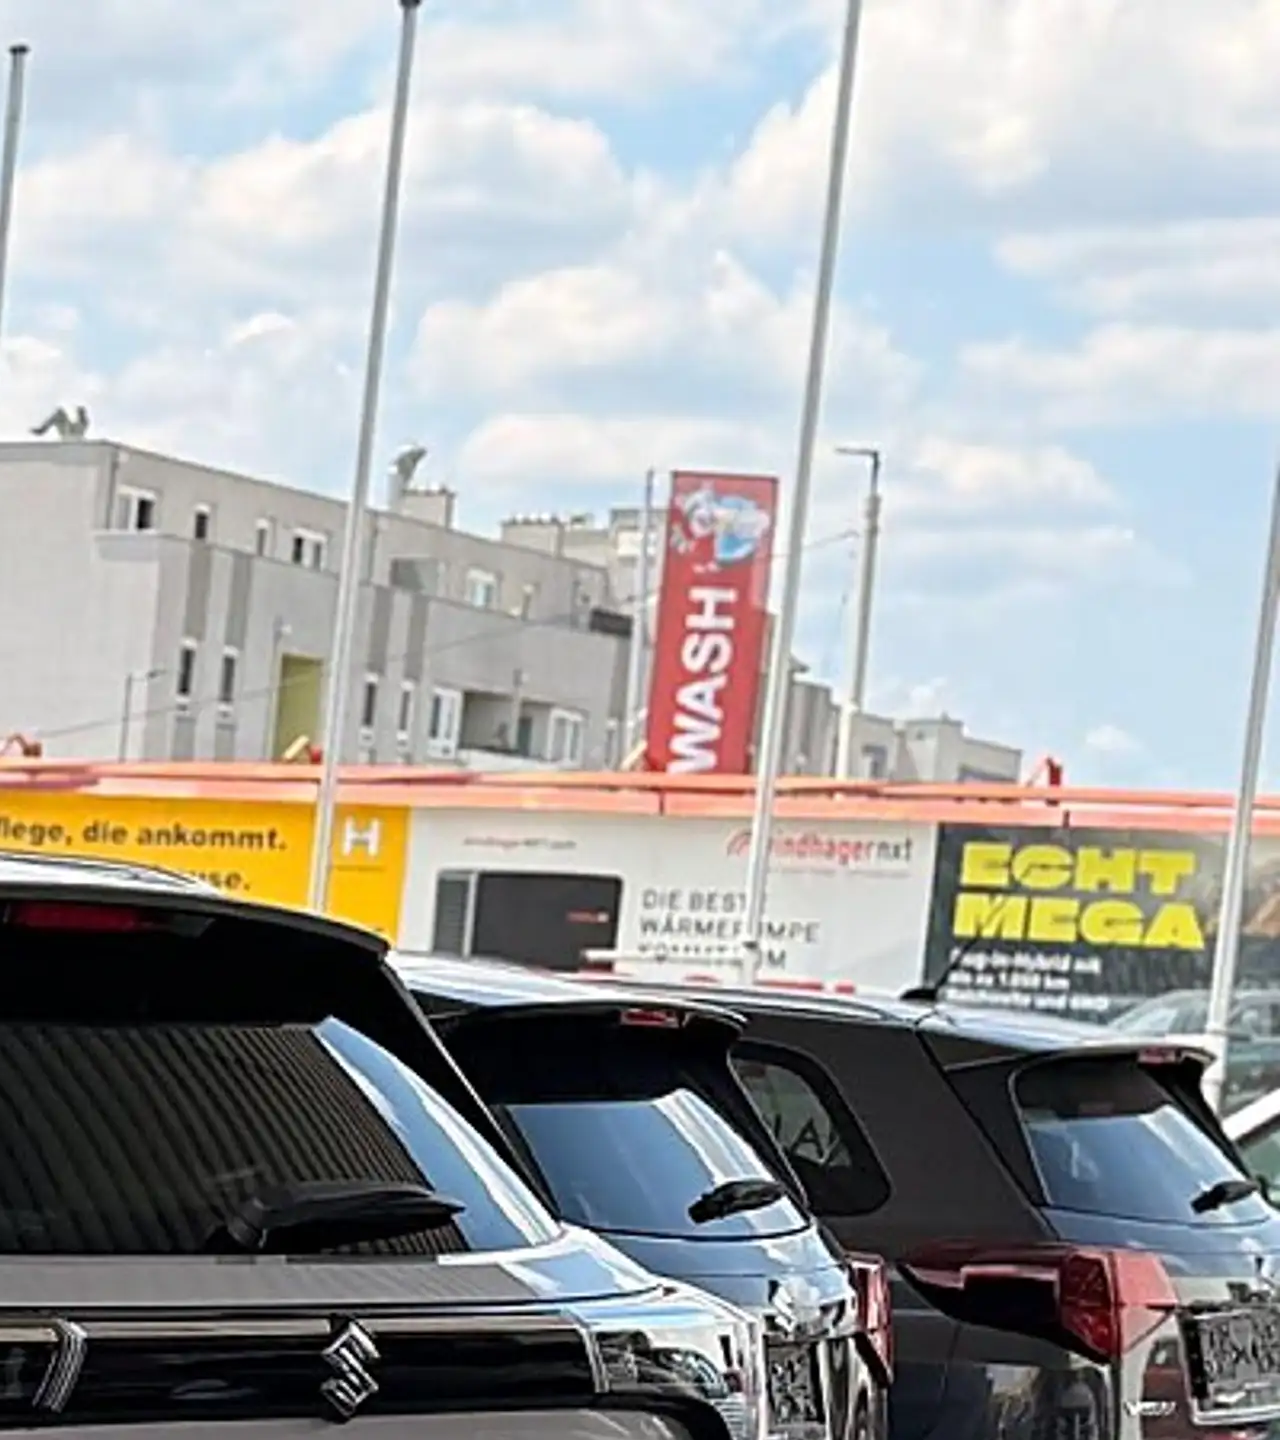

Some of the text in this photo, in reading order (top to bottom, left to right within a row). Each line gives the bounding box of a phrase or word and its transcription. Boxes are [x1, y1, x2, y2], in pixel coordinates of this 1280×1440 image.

[666, 587, 737, 775] WASH
[82, 820, 129, 845] die
[136, 823, 288, 851] ankommt.
[959, 841, 1195, 894] ECHT
[642, 888, 748, 914] DIE BEST
[952, 892, 1206, 950] MEGA
